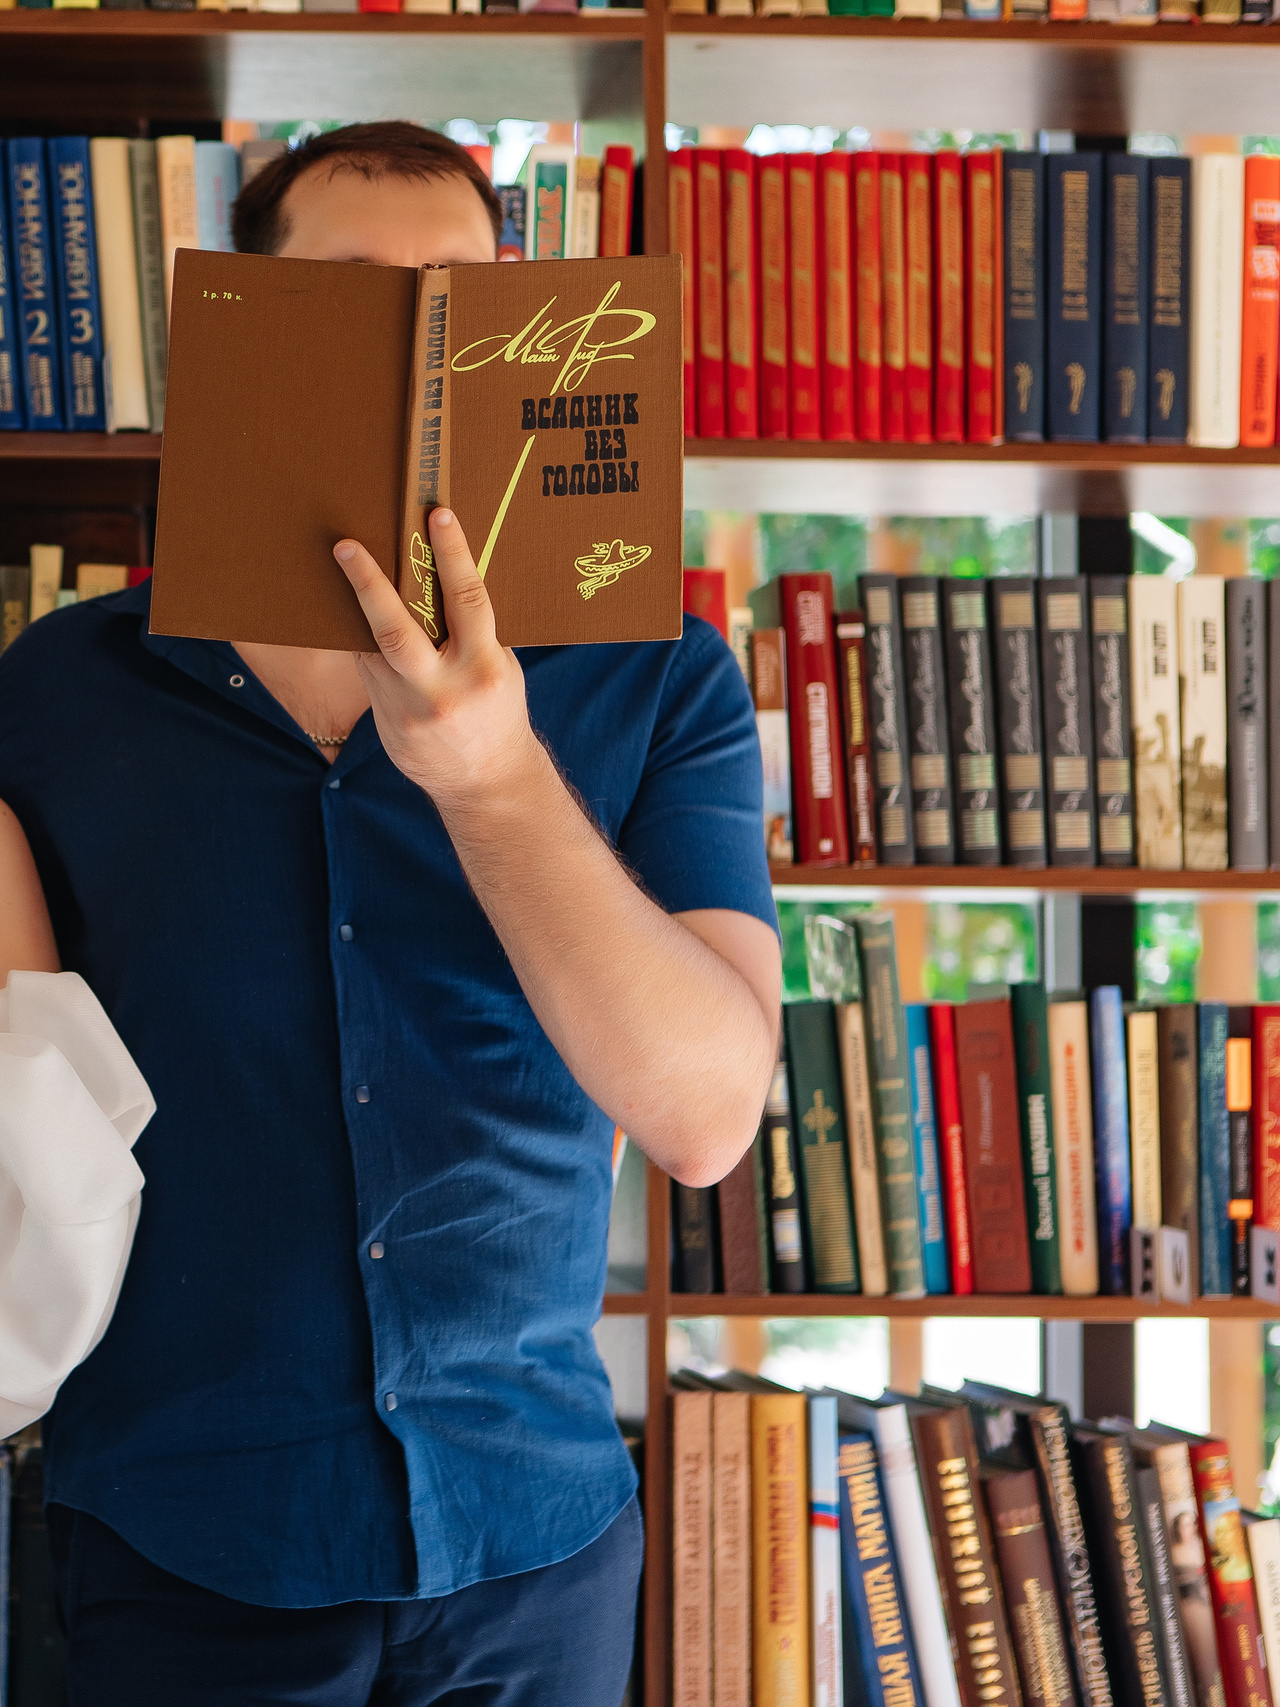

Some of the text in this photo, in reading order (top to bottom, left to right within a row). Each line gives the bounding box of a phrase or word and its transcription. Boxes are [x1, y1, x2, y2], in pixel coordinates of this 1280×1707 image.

[14, 160, 47, 300] ИЗБРАННОЕ
[58, 160, 92, 300] ИЗБРАННОЕ
[26, 308, 51, 346] 2
[70, 307, 95, 345] 3
[203, 290, 208, 298] 2
[211, 292, 219, 300] р.
[223, 291, 232, 300] 70
[451, 280, 657, 396] Майн Рид
[418, 292, 448, 506] ВСАДНИК БЕЗ ГОЛОВЫ
[521, 392, 639, 430] ВСАДНИК
[542, 461, 640, 497] ГОЛОВЫ
[584, 428, 628, 461] БЕЗ
[408, 531, 439, 639] Майн Рид
[846, 1472, 891, 1561] МАГИИ
[1040, 1406, 1084, 1560] ЖИВОПИСИ
[867, 1562, 906, 1649] КНИГА
[1067, 1562, 1099, 1633] АТЛАС
[1102, 1445, 1164, 1707] ГИБЕЛЬ ЦАРСКОЙ СЕМЬИ
